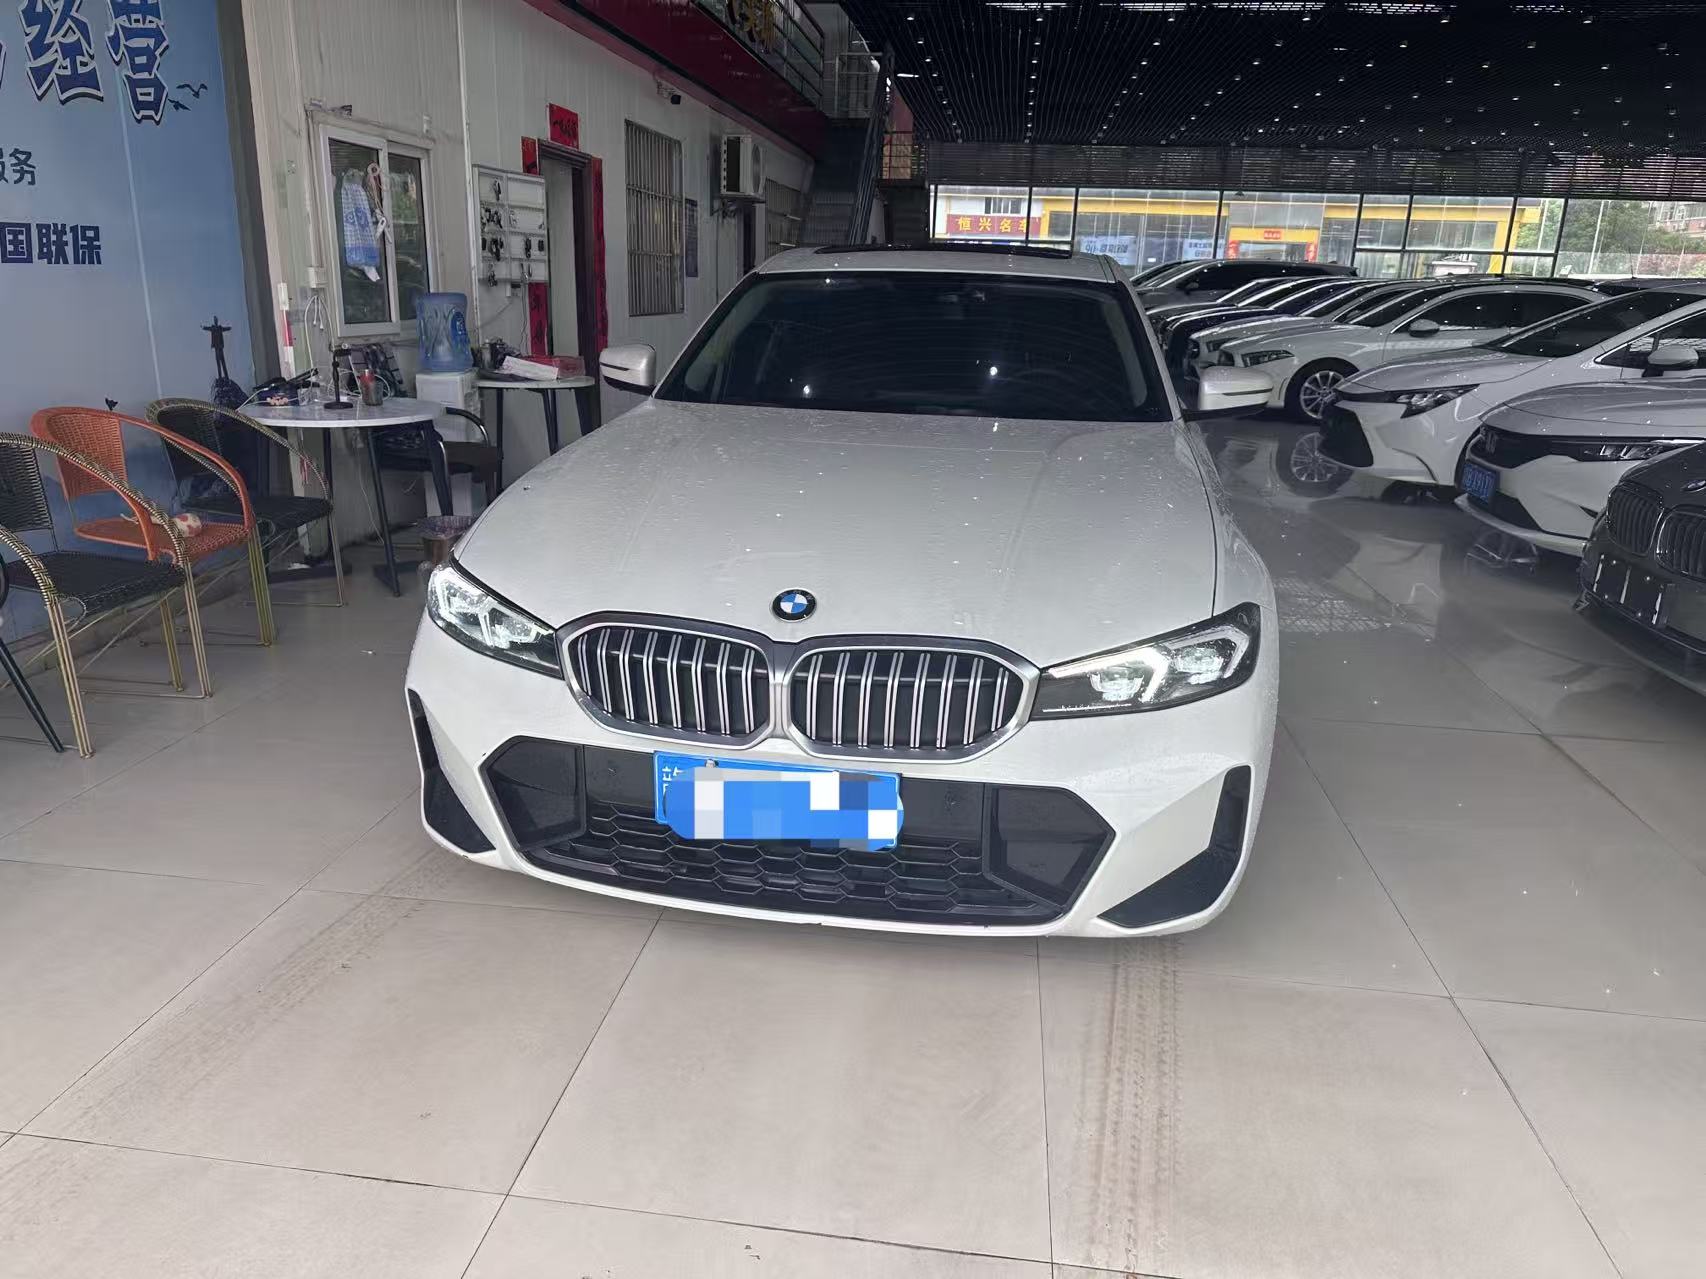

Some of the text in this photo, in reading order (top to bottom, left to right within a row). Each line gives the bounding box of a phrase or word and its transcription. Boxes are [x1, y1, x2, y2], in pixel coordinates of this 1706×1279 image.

[0, 0, 170, 125] 经营
[0, 222, 102, 265] 国联保
